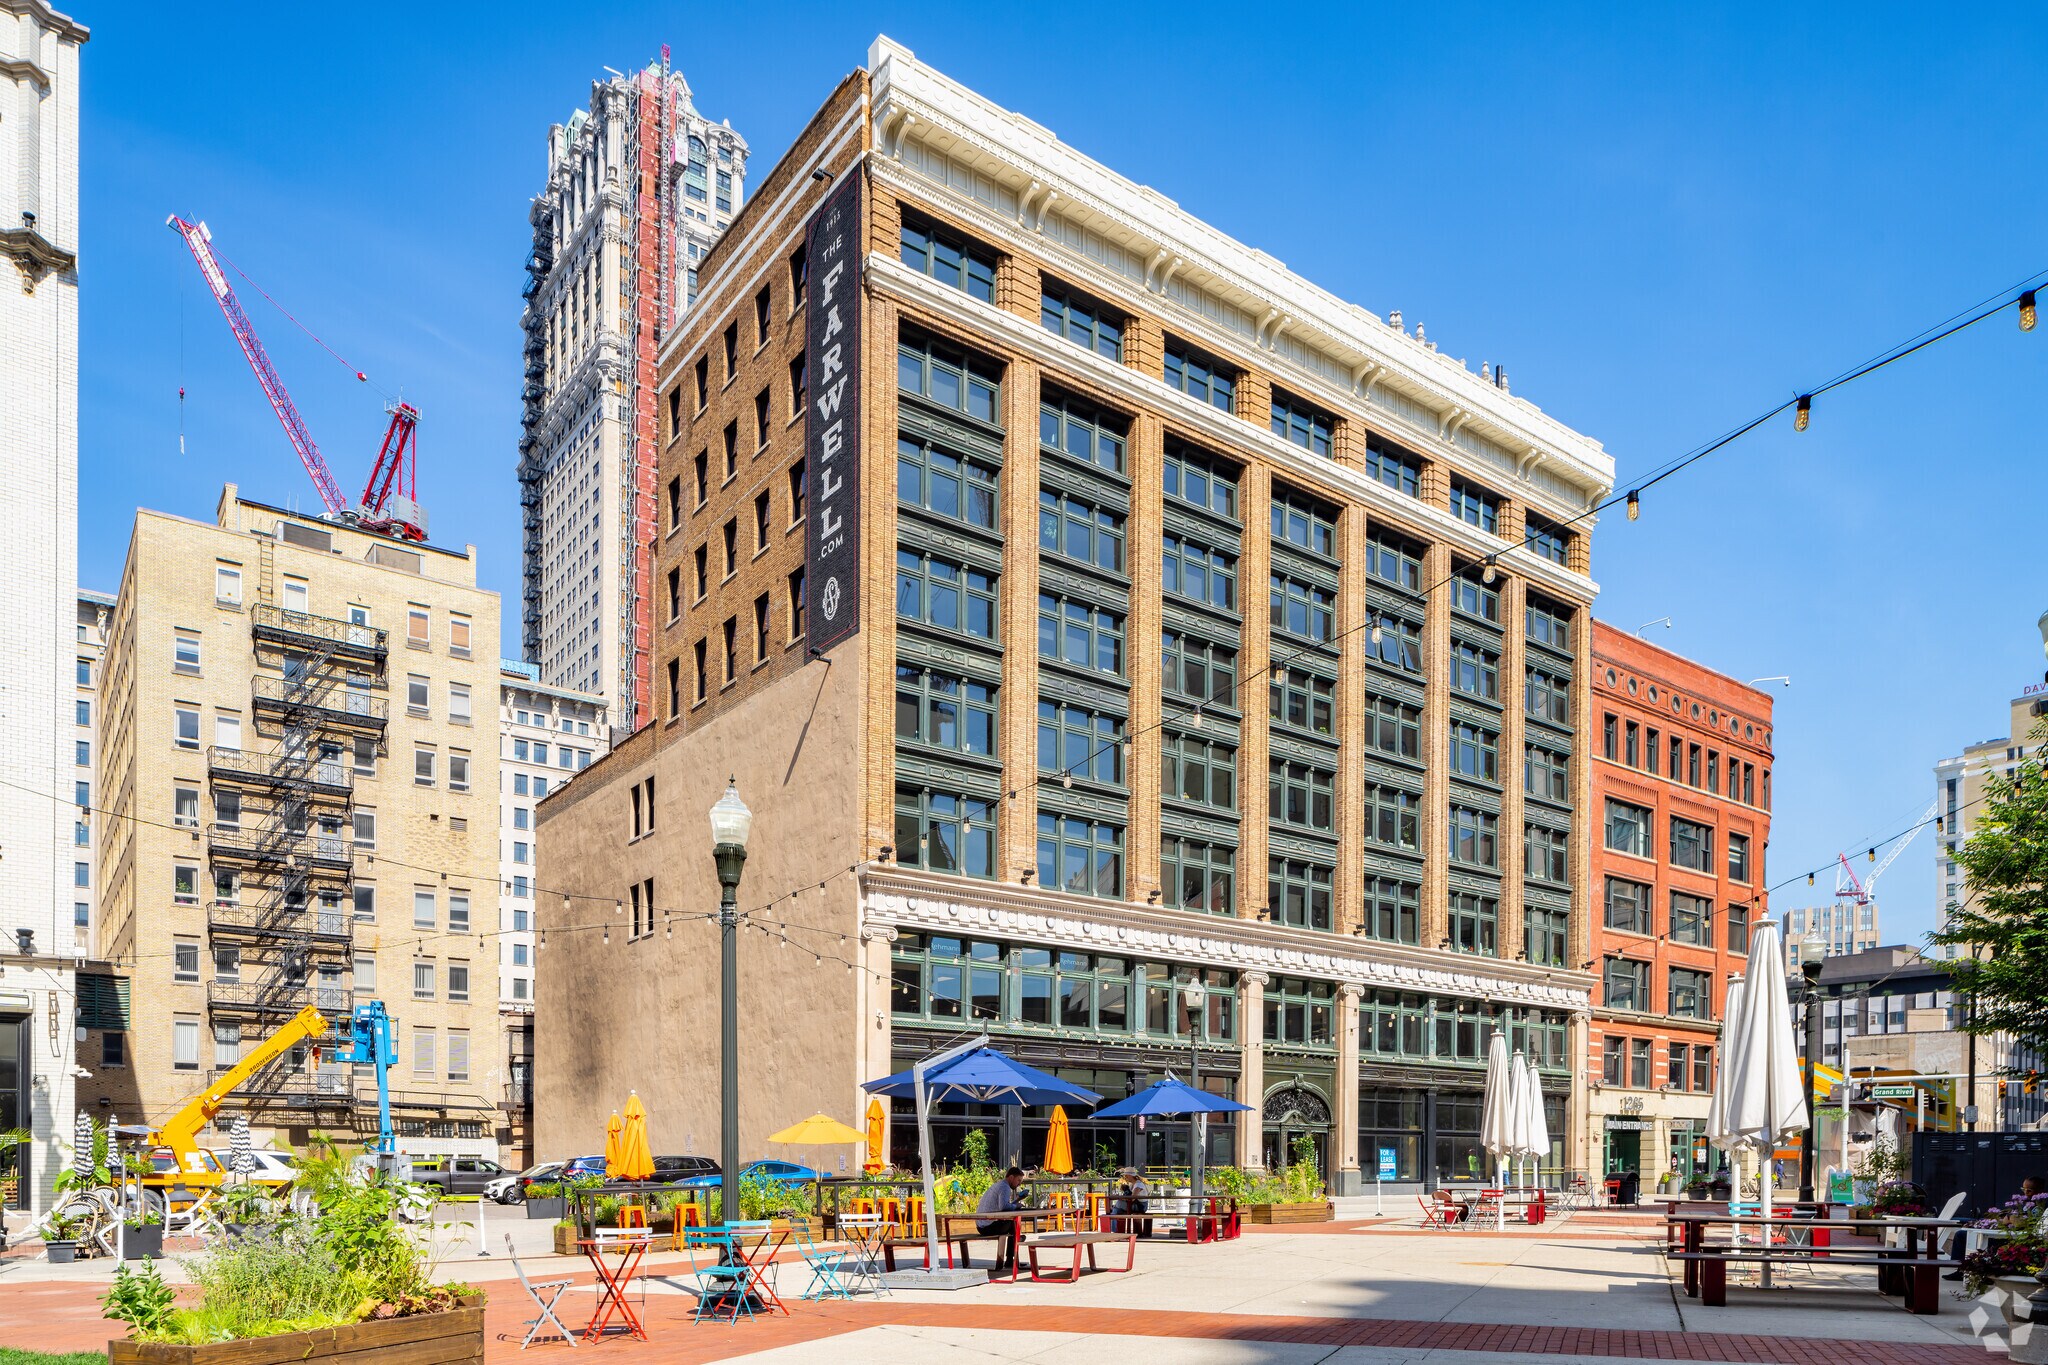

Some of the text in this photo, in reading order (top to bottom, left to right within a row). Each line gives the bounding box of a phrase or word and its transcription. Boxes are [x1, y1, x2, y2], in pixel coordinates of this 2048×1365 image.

[822, 233, 842, 263] THE
[816, 259, 848, 541] FARWELL
[817, 533, 844, 562] .COM
[1623, 1096, 1644, 1111] 1265
[1605, 1120, 1622, 1131] MAIN
[1622, 1120, 1653, 1131] ENTRANCE
